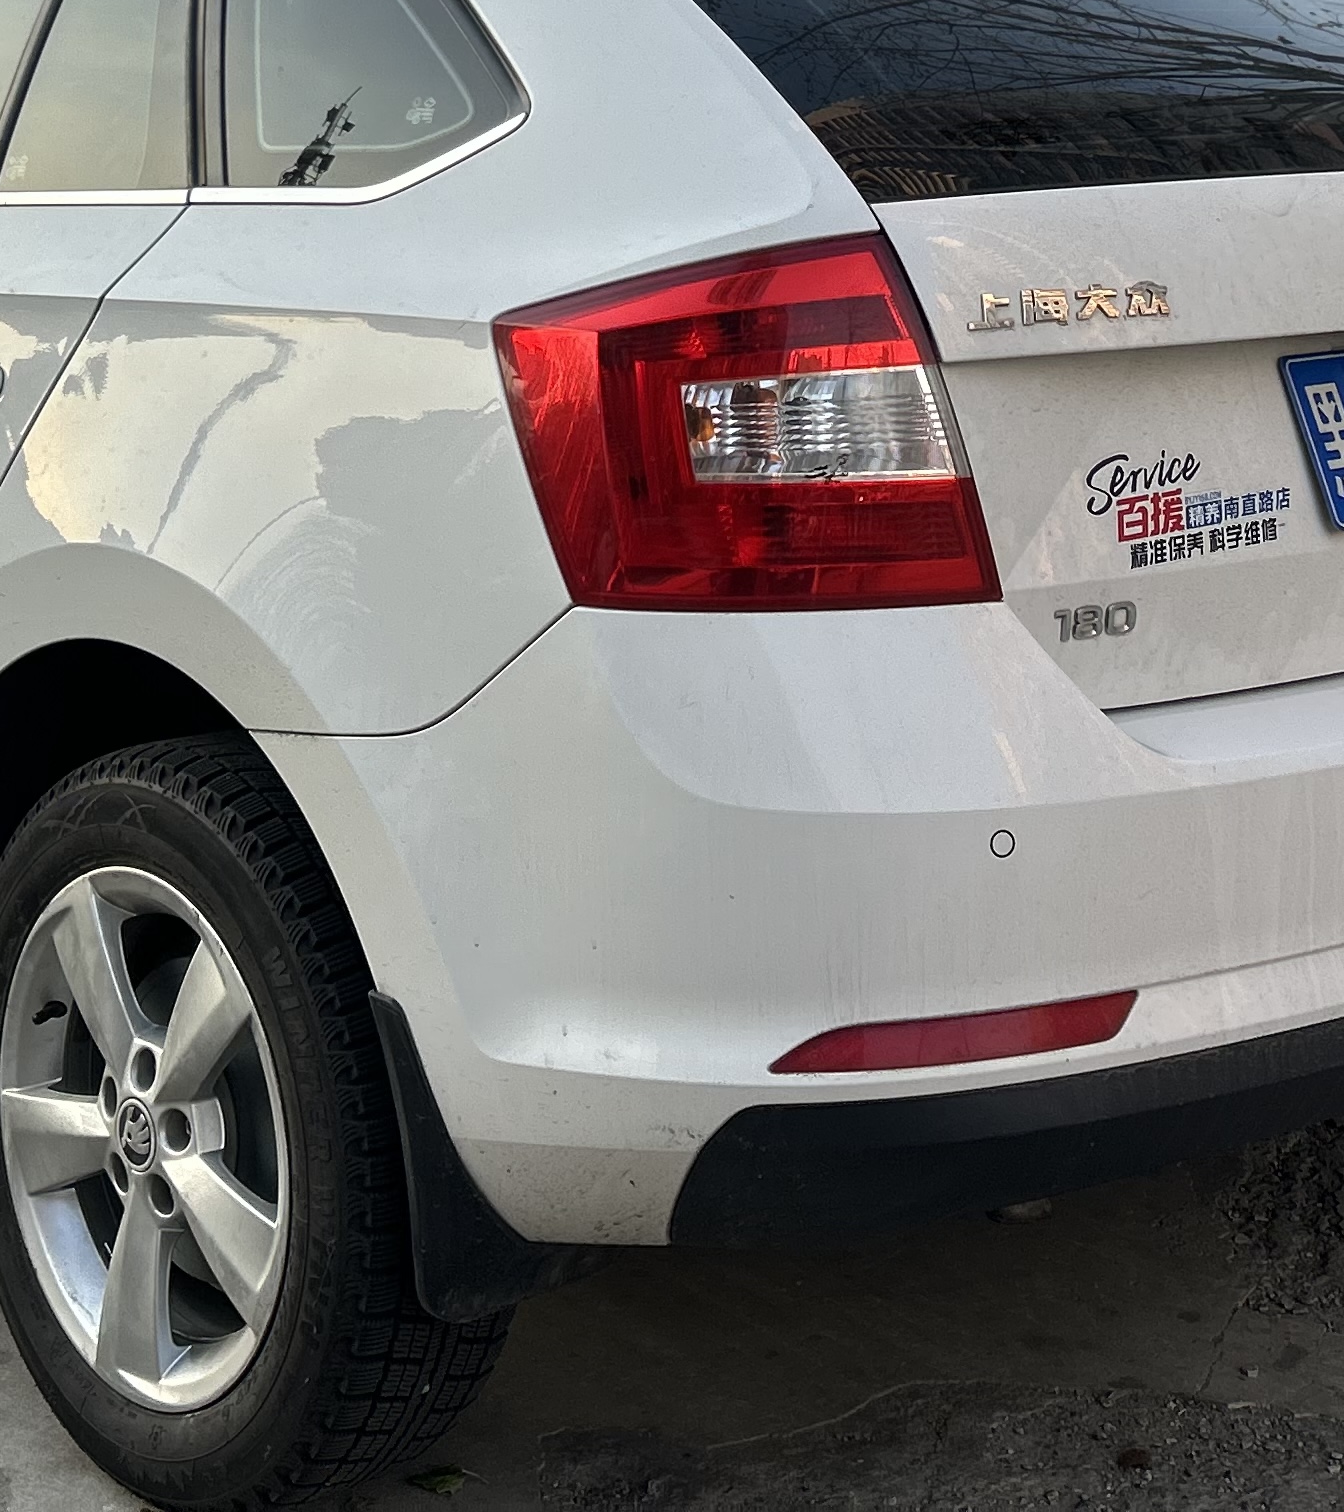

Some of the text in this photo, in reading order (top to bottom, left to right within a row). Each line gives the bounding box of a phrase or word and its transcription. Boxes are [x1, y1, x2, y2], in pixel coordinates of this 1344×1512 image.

[967, 280, 1170, 331] 上海大众
[1086, 450, 1201, 515] Service
[1054, 601, 1136, 642] 180
[262, 946, 333, 1163] WINTER
